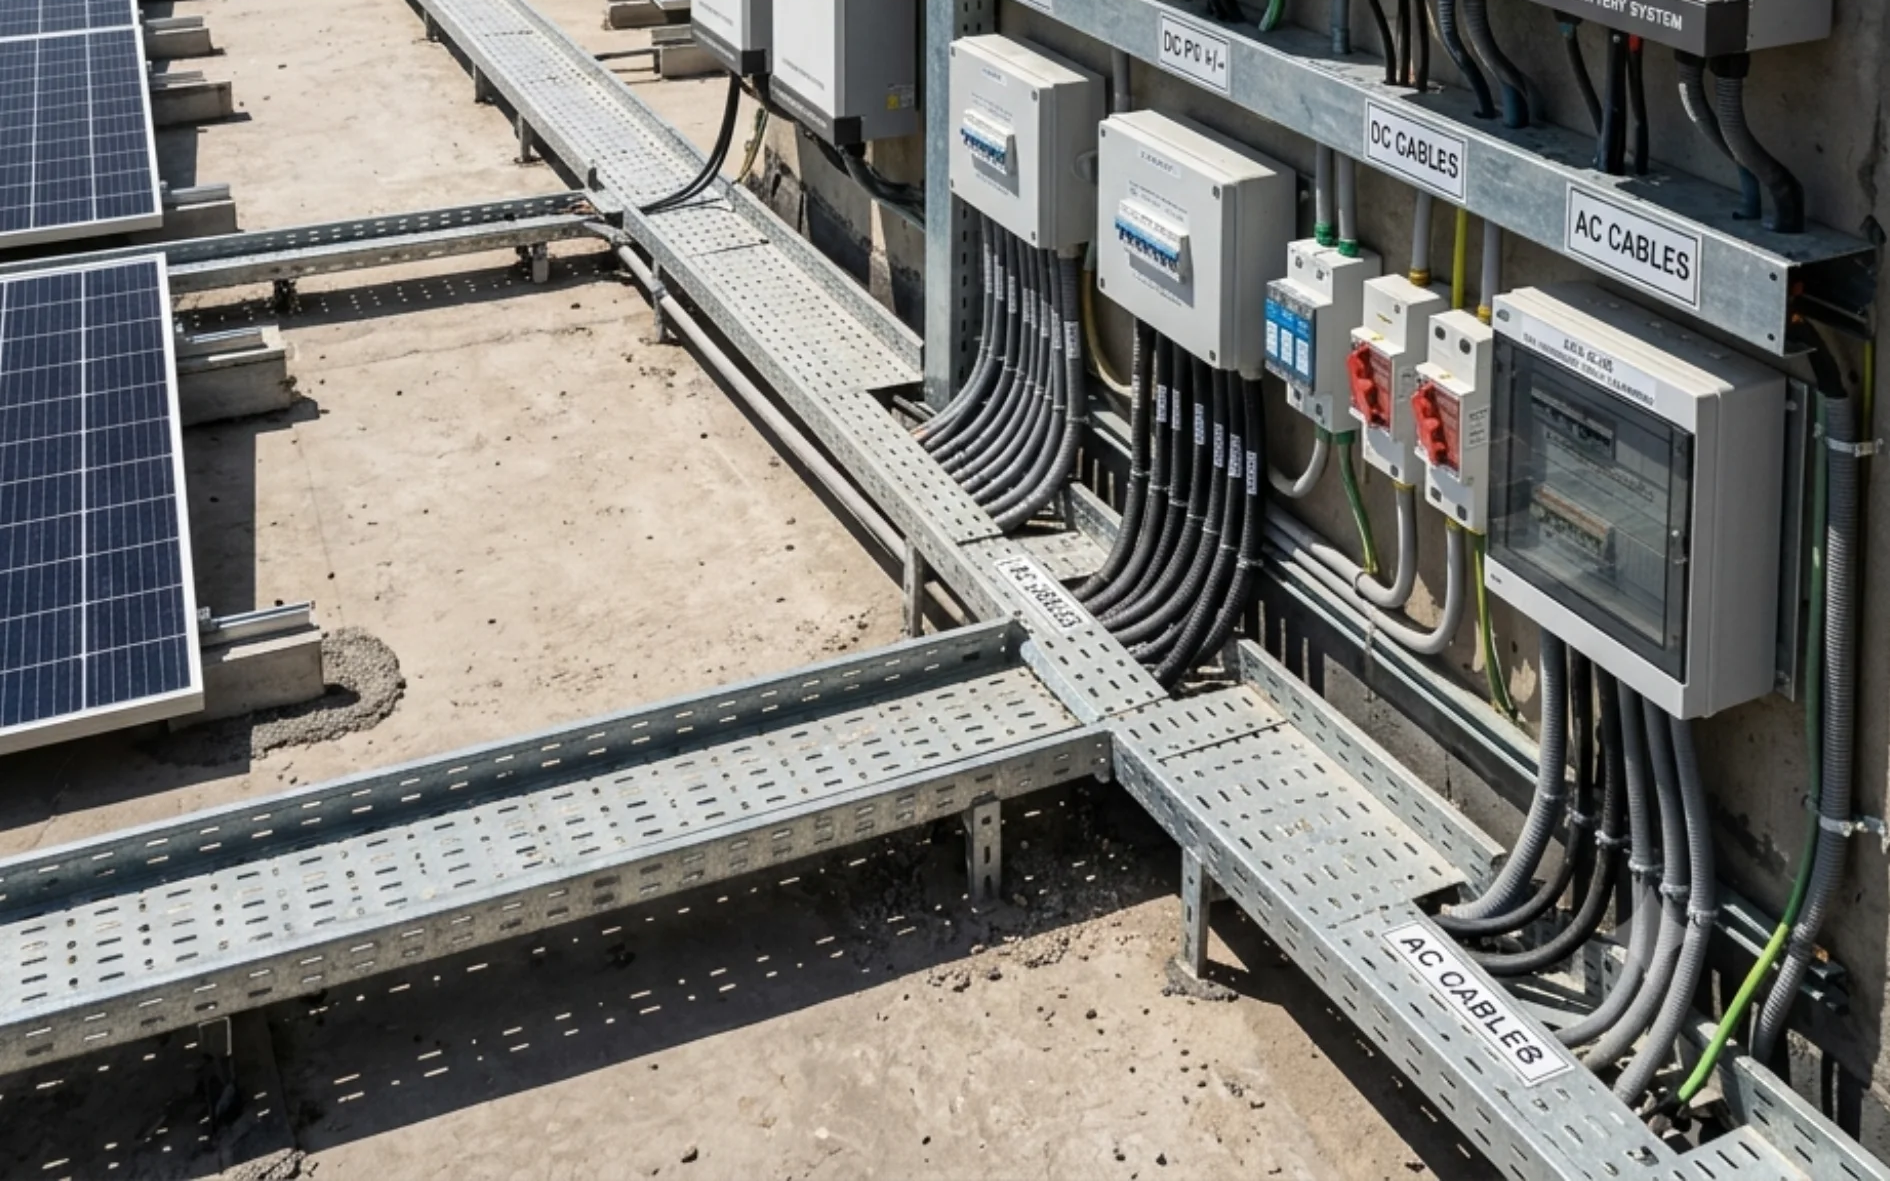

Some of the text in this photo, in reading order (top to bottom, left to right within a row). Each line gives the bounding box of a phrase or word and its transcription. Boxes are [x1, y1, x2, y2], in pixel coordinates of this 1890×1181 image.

[1629, 1, 1683, 31] SYSTEM
[1574, 209, 1690, 281] AC CABLES
[1400, 937, 1444, 967] AC
